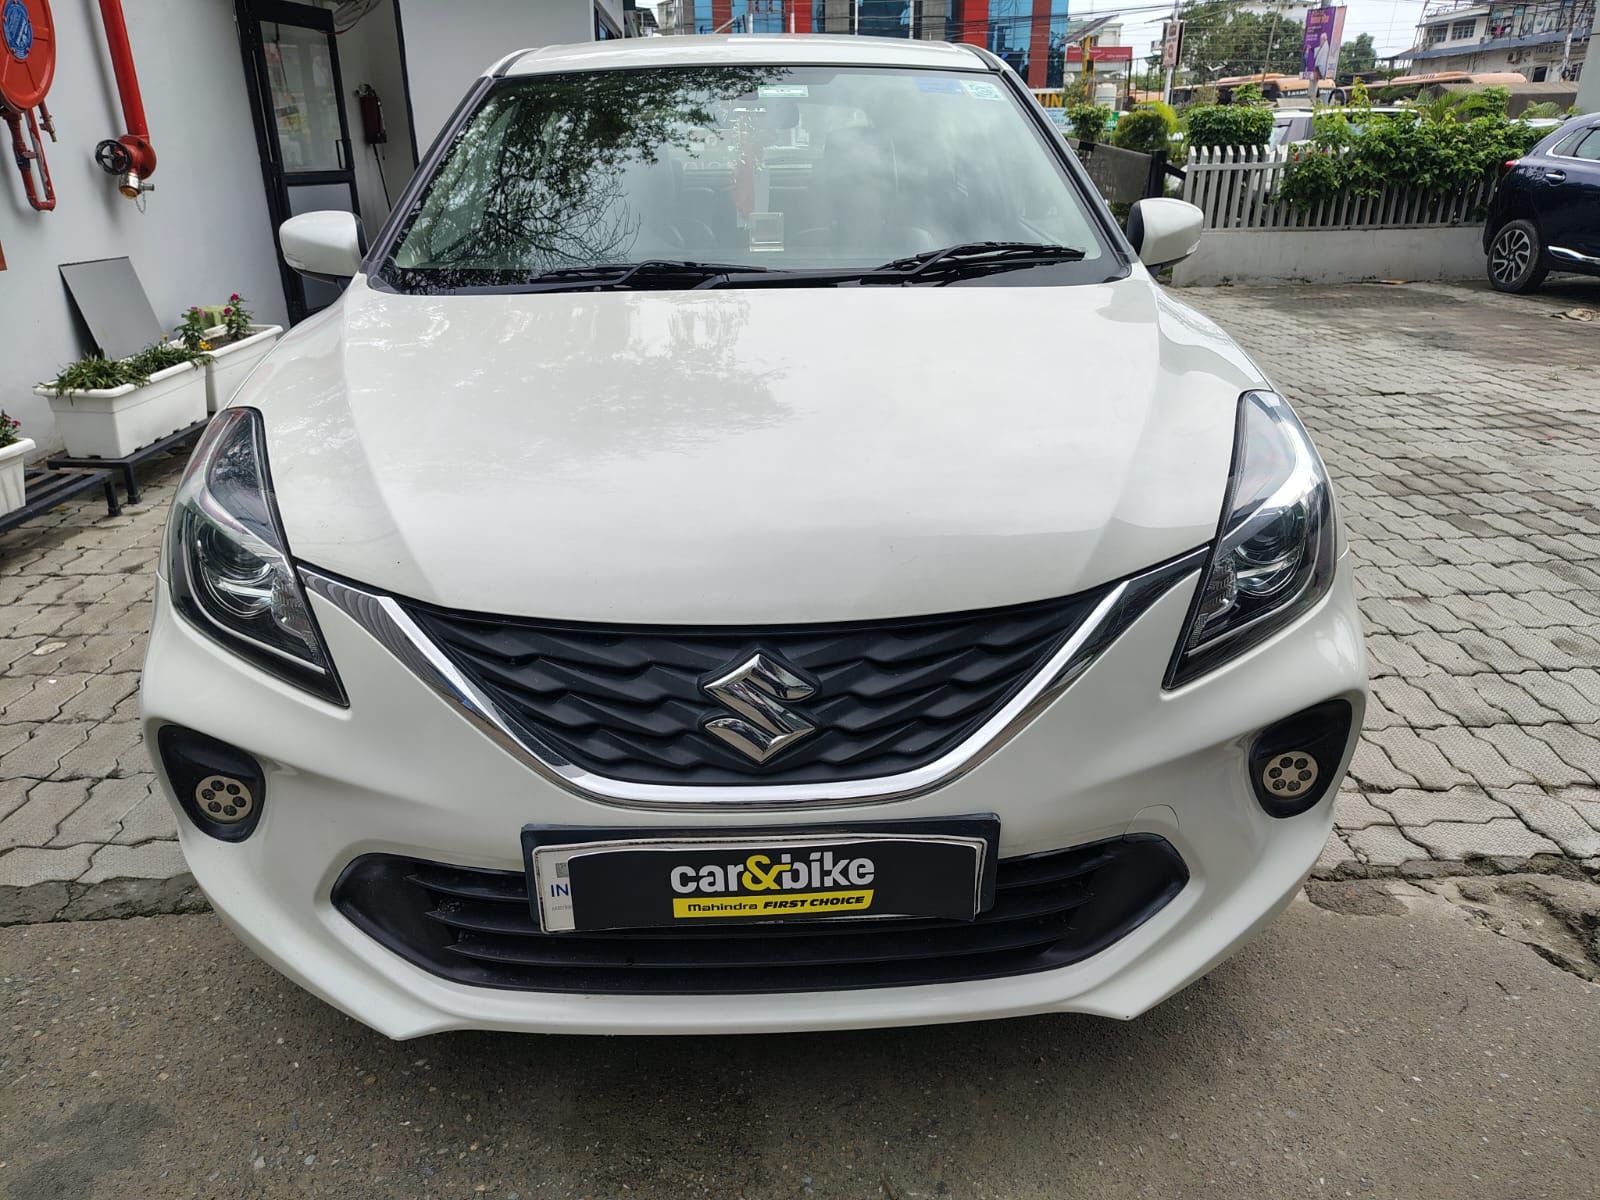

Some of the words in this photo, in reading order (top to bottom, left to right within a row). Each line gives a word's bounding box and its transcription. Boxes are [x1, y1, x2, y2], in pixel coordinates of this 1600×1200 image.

[670, 851, 875, 894] car&bike
[687, 901, 758, 912] Mahindra
[763, 899, 808, 910] FIRST
[809, 895, 865, 906] CHOICE
